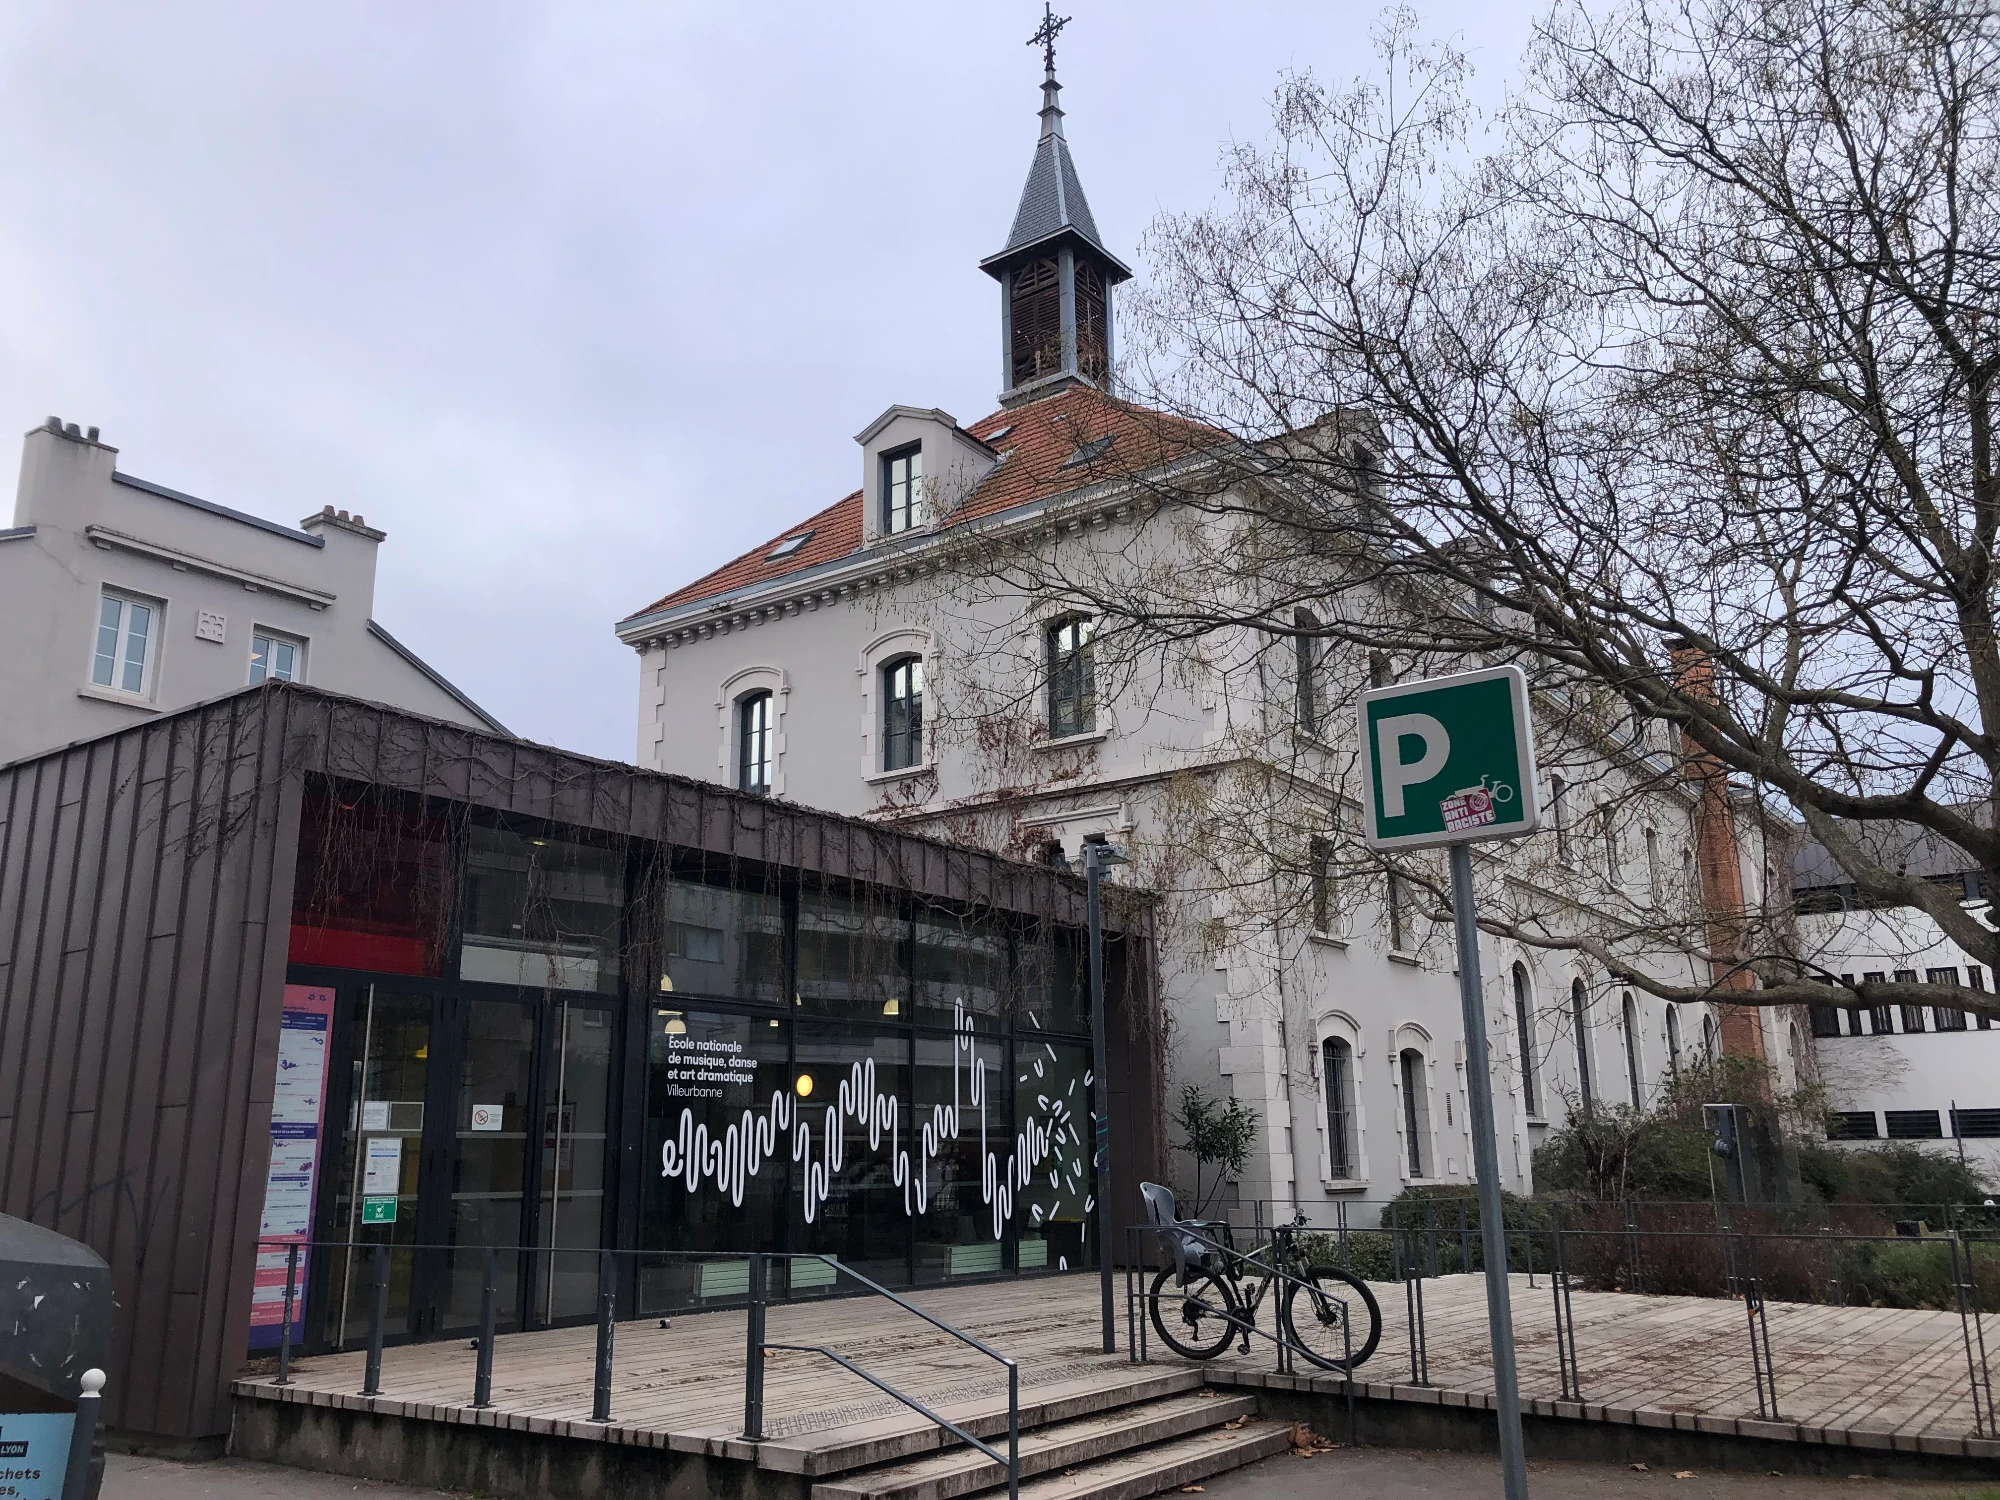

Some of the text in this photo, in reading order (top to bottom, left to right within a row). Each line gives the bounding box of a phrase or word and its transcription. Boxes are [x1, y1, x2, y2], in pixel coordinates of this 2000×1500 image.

[1376, 712, 1451, 818] P
[1441, 797, 1467, 811] ZONE
[1444, 806, 1469, 821] ANTI
[1446, 810, 1495, 832] RACISTE
[696, 1039, 742, 1053] nationale
[668, 1051, 758, 1070] de musique, danse
[667, 1068, 754, 1086] et art dramatique
[666, 1083, 723, 1097] Villeurbanne
[1, 1445, 25, 1454] LYON
